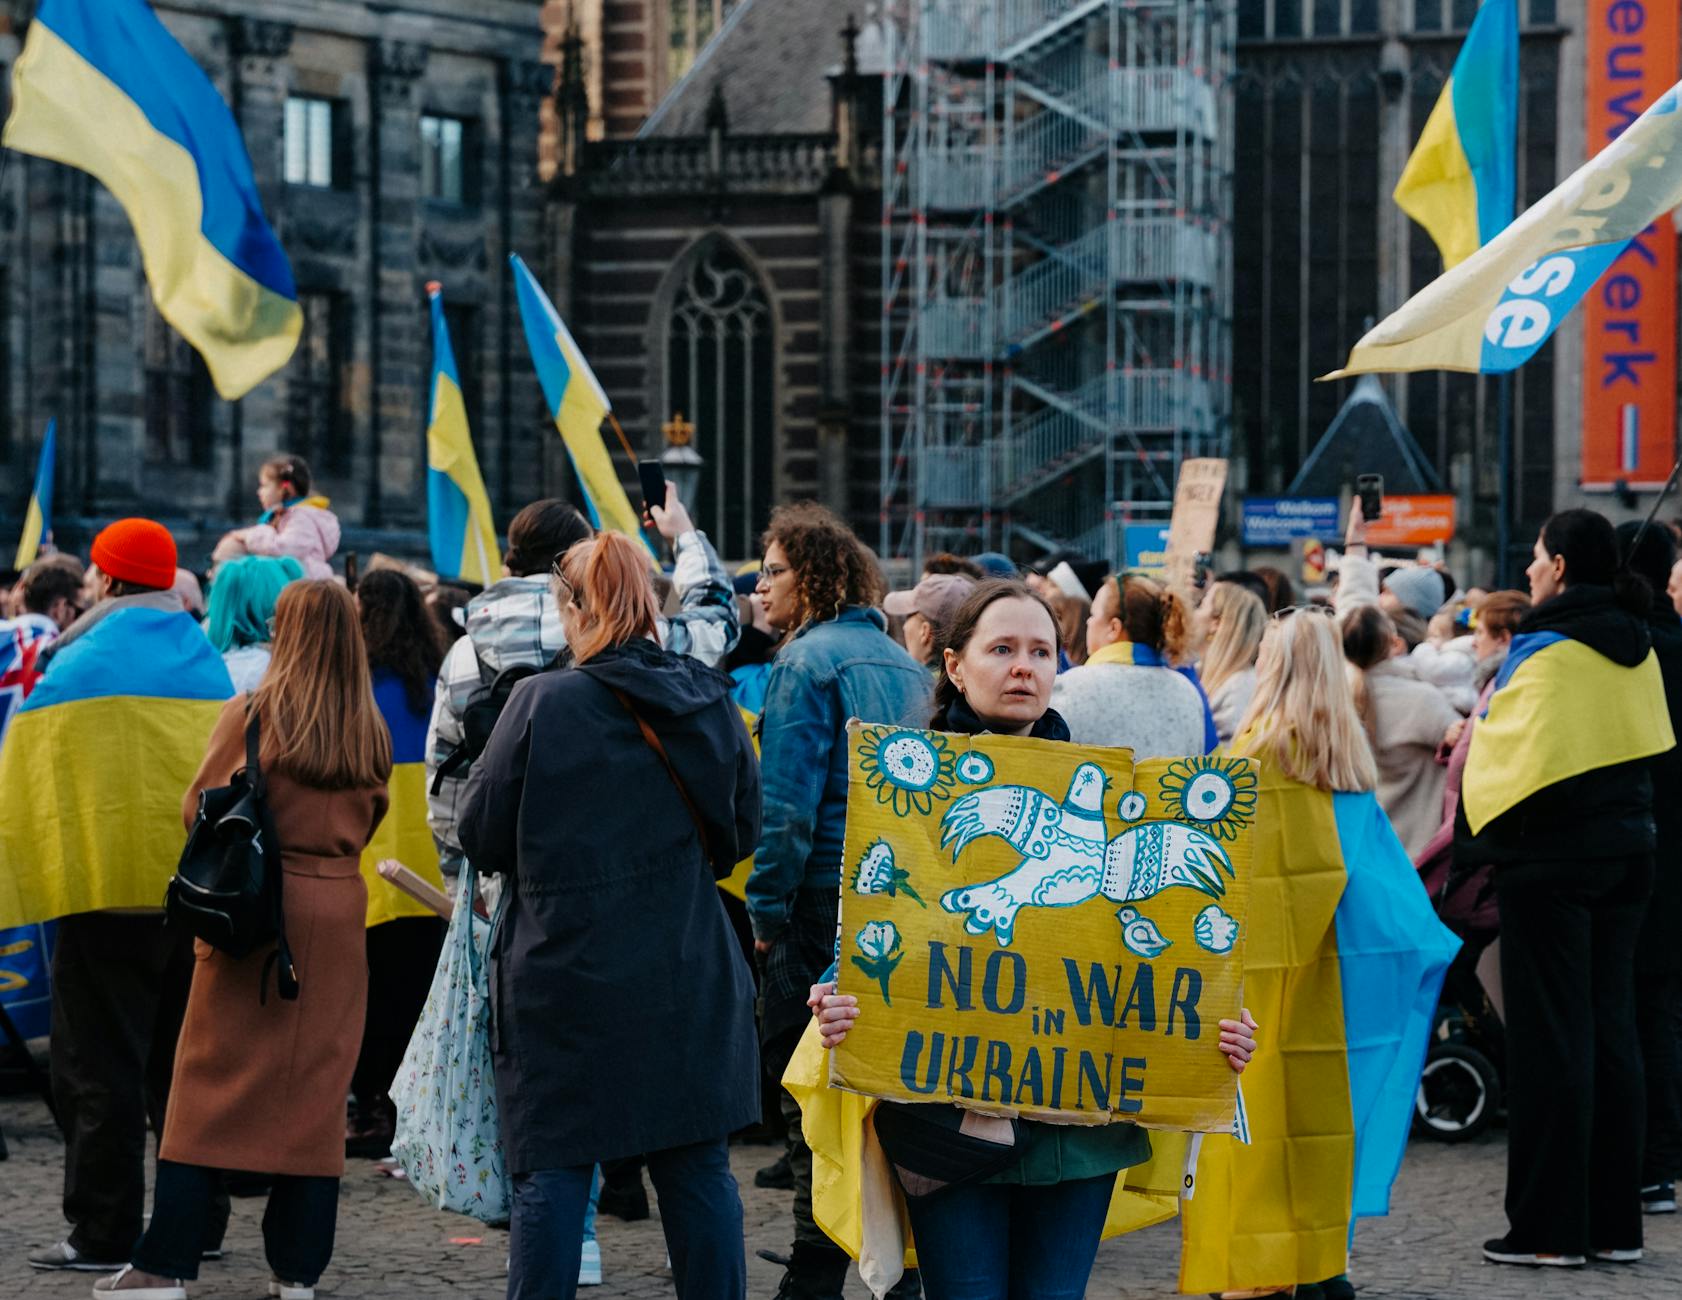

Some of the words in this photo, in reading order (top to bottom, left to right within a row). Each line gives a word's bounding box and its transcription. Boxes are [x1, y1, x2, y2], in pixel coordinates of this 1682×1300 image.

[926, 940, 1027, 1015] NO
[1062, 957, 1204, 1041] WAR
[899, 1030, 1148, 1114] UKRAINE
